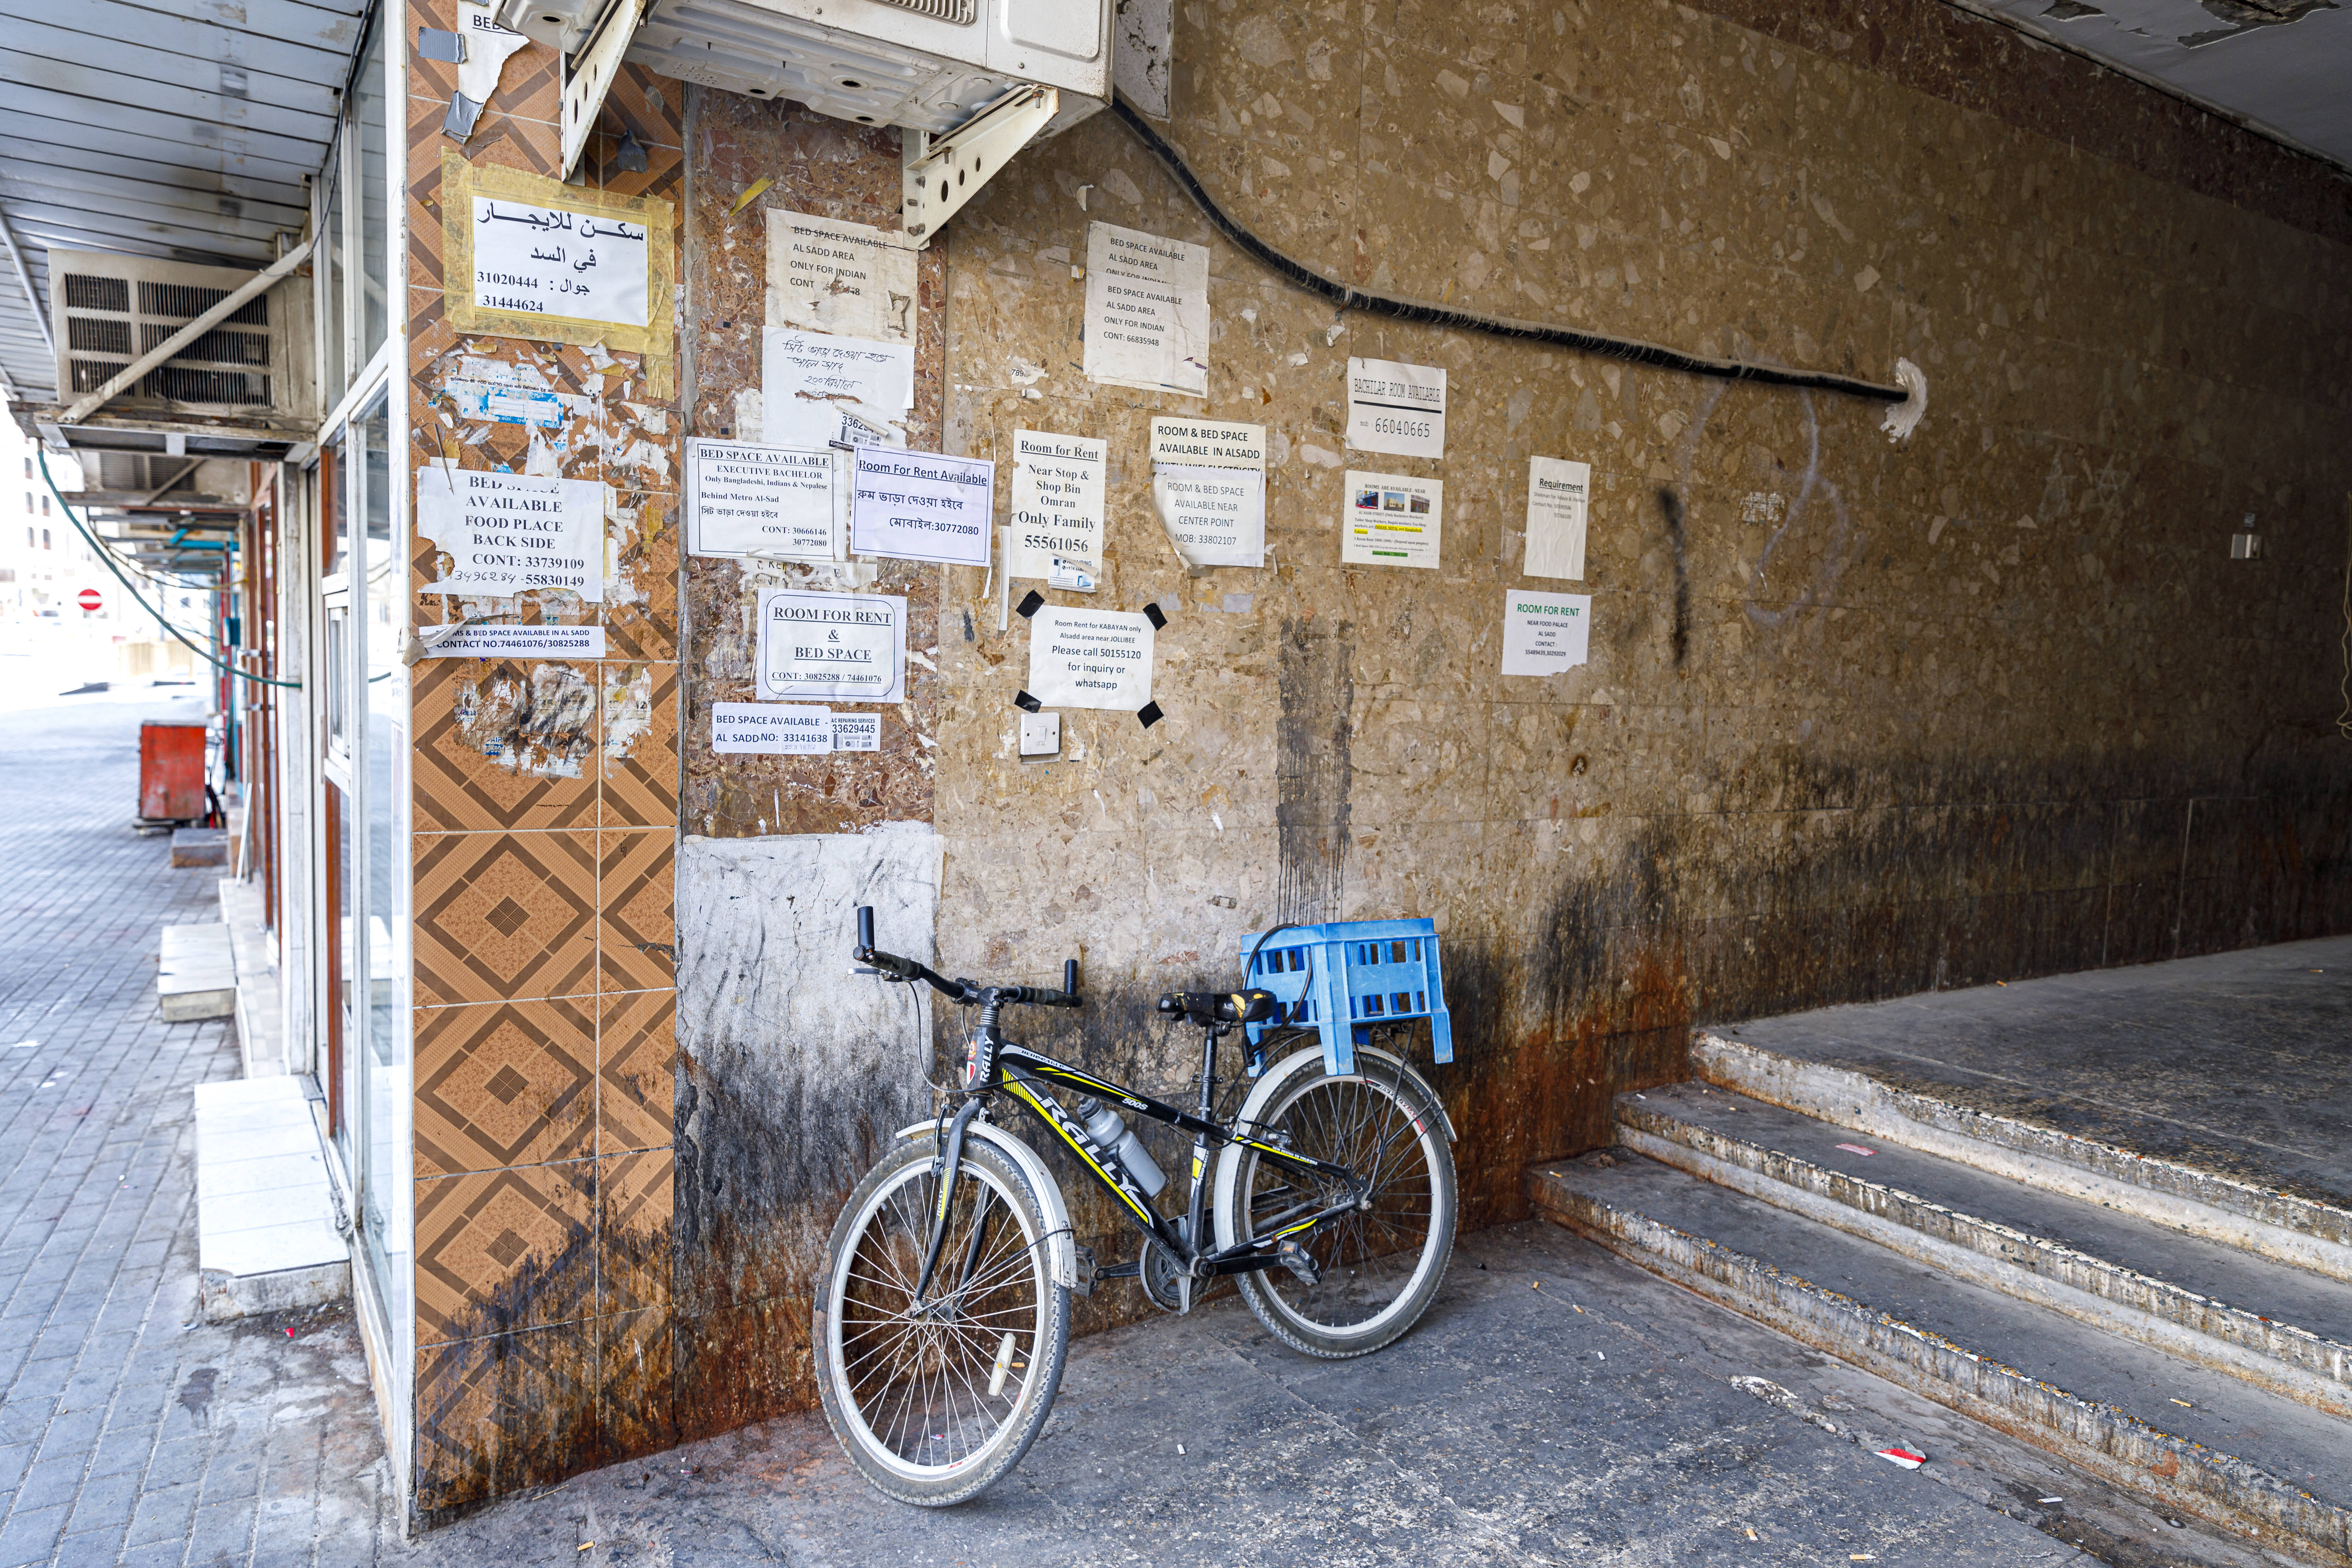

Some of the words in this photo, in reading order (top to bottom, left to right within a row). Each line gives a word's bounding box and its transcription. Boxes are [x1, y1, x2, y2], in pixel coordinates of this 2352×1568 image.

[531, 246, 565, 263] السد
[574, 249, 596, 273] في
[791, 261, 814, 271] ONLY
[817, 265, 833, 274] FOR
[836, 268, 866, 279] INDIAN
[478, 272, 538, 288] 31020444
[560, 278, 590, 295] جوال
[483, 295, 543, 312] 31444624
[1123, 289, 1144, 298] SPACE
[1146, 293, 1182, 305] AVAILABLE
[1104, 317, 1123, 325] ONLY
[1140, 322, 1164, 332] INDIAN
[1104, 332, 1125, 341] CONT:
[1127, 335, 1159, 346] 66835948
[1354, 378, 1385, 395] BACHILAR
[1389, 383, 1405, 398] ROOM
[1408, 385, 1440, 402] AVAILABLE
[1158, 426, 1187, 436] ROOM
[1191, 428, 1198, 437] &
[1201, 429, 1218, 439] BED
[1221, 431, 1248, 441] SPACE
[1376, 418, 1429, 437] 66040665
[701, 449, 723, 458] BED
[727, 451, 762, 461] SPACE
[766, 455, 828, 466] AVAILABLE
[1021, 441, 1051, 453] Room
[1056, 445, 1070, 455] for
[1075, 447, 1098, 459] Rent
[1159, 444, 1208, 455] AVAILABLE
[1214, 447, 1222, 456] IN
[1225, 449, 1259, 458] ALSADD
[718, 465, 770, 475] EXECUTIVE
[774, 469, 822, 479] BACHELOR
[859, 460, 890, 473] Room
[894, 464, 911, 475] For
[914, 467, 937, 478] Rent
[941, 471, 987, 484] Available
[1029, 465, 1052, 475] Near
[1056, 468, 1077, 481] Stop
[1081, 471, 1088, 480] &
[724, 477, 765, 485] Bangladeshi,
[1036, 480, 1061, 493] Shop
[1065, 484, 1080, 493] Bin
[1540, 479, 1583, 491] Requirement
[1168, 482, 1192, 492] ROOM
[1204, 486, 1218, 494] BED
[1221, 487, 1244, 496] SPACE
[466, 496, 562, 512] AVAILABLE
[1041, 496, 1075, 508] Omran
[1175, 499, 1215, 510] AVAILABLE
[1218, 503, 1238, 511] NEAR
[466, 516, 508, 528] FOOD
[514, 519, 563, 532] PLACE
[1019, 511, 1049, 528] Only
[1054, 515, 1095, 532] Family
[1179, 516, 1208, 525] CENTER
[1211, 518, 1234, 527] POINT
[474, 534, 516, 546] BACK
[521, 537, 555, 549] SIDE
[1025, 535, 1088, 552] 55561056
[1175, 534, 1196, 542] MOB:
[1199, 535, 1236, 545] 33802107
[473, 554, 520, 566] CONT:
[526, 557, 584, 569] 33739109
[450, 571, 516, 584] 3496284
[774, 607, 817, 619] ROOM
[824, 610, 851, 621] FOR
[856, 612, 891, 623] RENT
[1518, 604, 1541, 613] ROOM
[1544, 606, 1558, 615] FOR
[1561, 607, 1579, 616] RENT
[828, 630, 839, 639] &
[483, 640, 589, 648] NO.74461076/30825288
[795, 647, 823, 658] BED
[828, 649, 871, 660] SPACE
[1052, 646, 1080, 655] Please
[1100, 649, 1140, 659] 50155120
[1068, 662, 1080, 671] for
[1084, 663, 1114, 675] inquiry
[1076, 679, 1117, 690] whatsapp
[832, 724, 875, 733] 33629445
[980, 1035, 994, 1083] RALLY
[1122, 1098, 1148, 1110] 500S
[1040, 1097, 1140, 1194] RALLY
